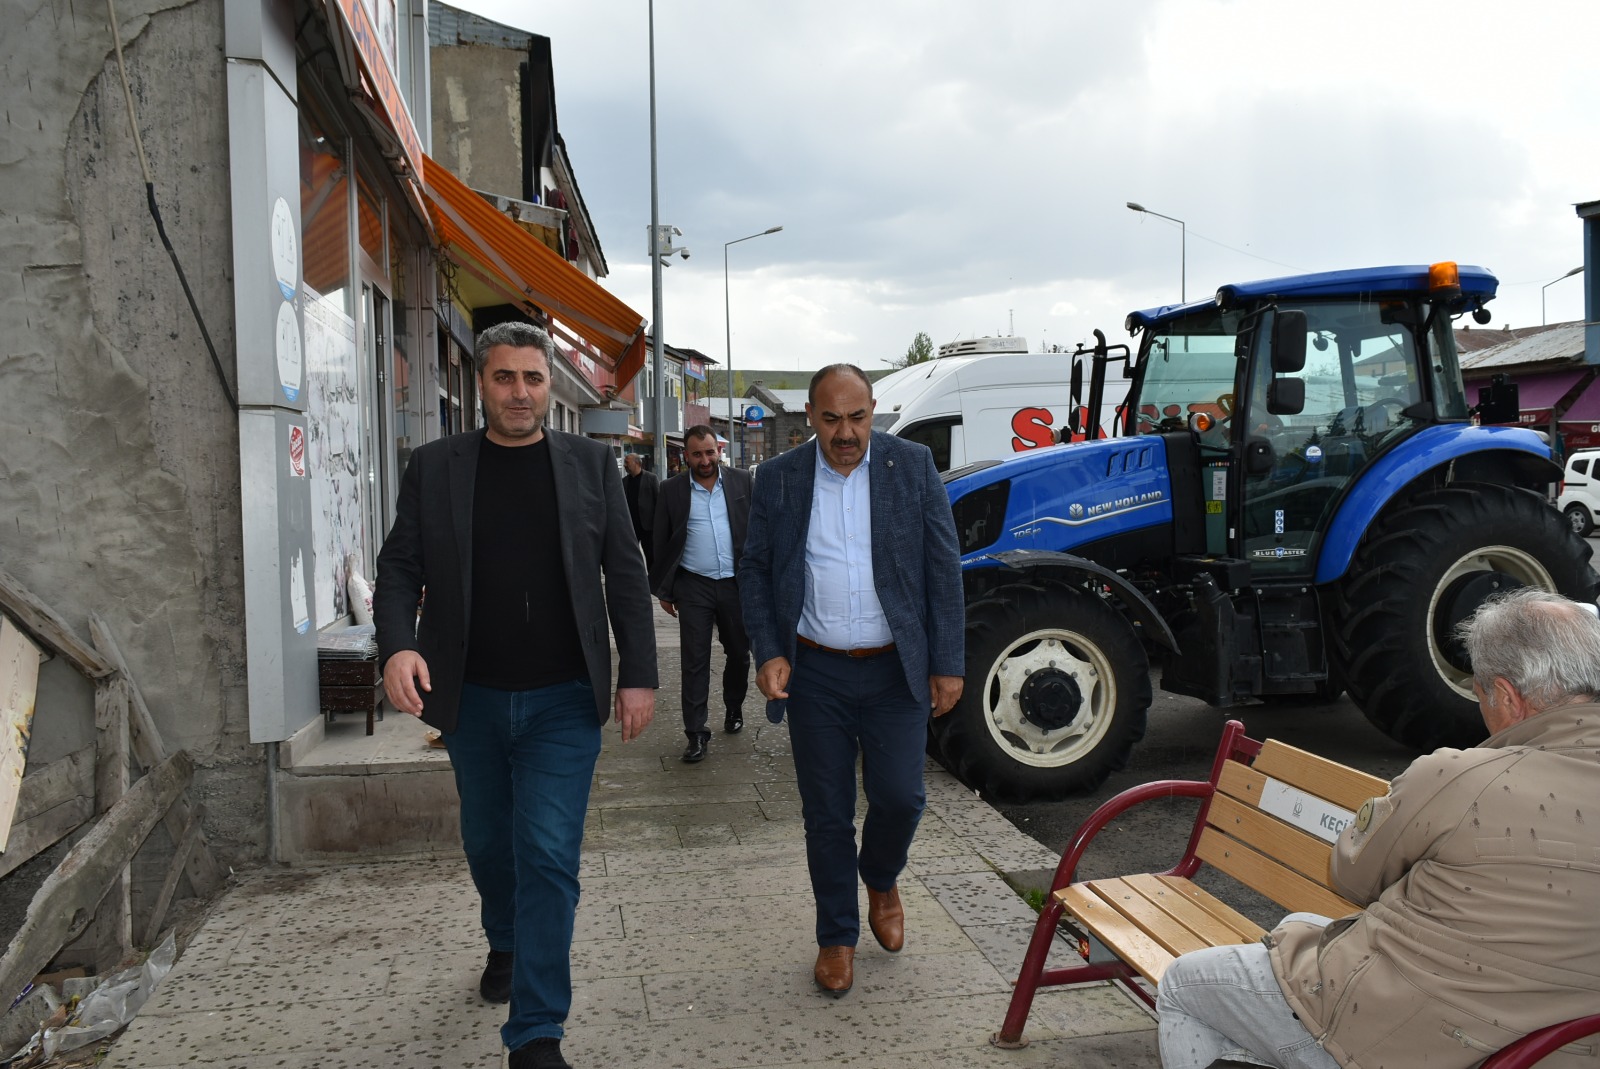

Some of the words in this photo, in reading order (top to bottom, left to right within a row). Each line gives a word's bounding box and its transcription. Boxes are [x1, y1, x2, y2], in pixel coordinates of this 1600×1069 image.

[1087, 501, 1113, 517] NEW
[1114, 490, 1163, 509] HOLLAND
[1319, 812, 1353, 836] KEÇİ
